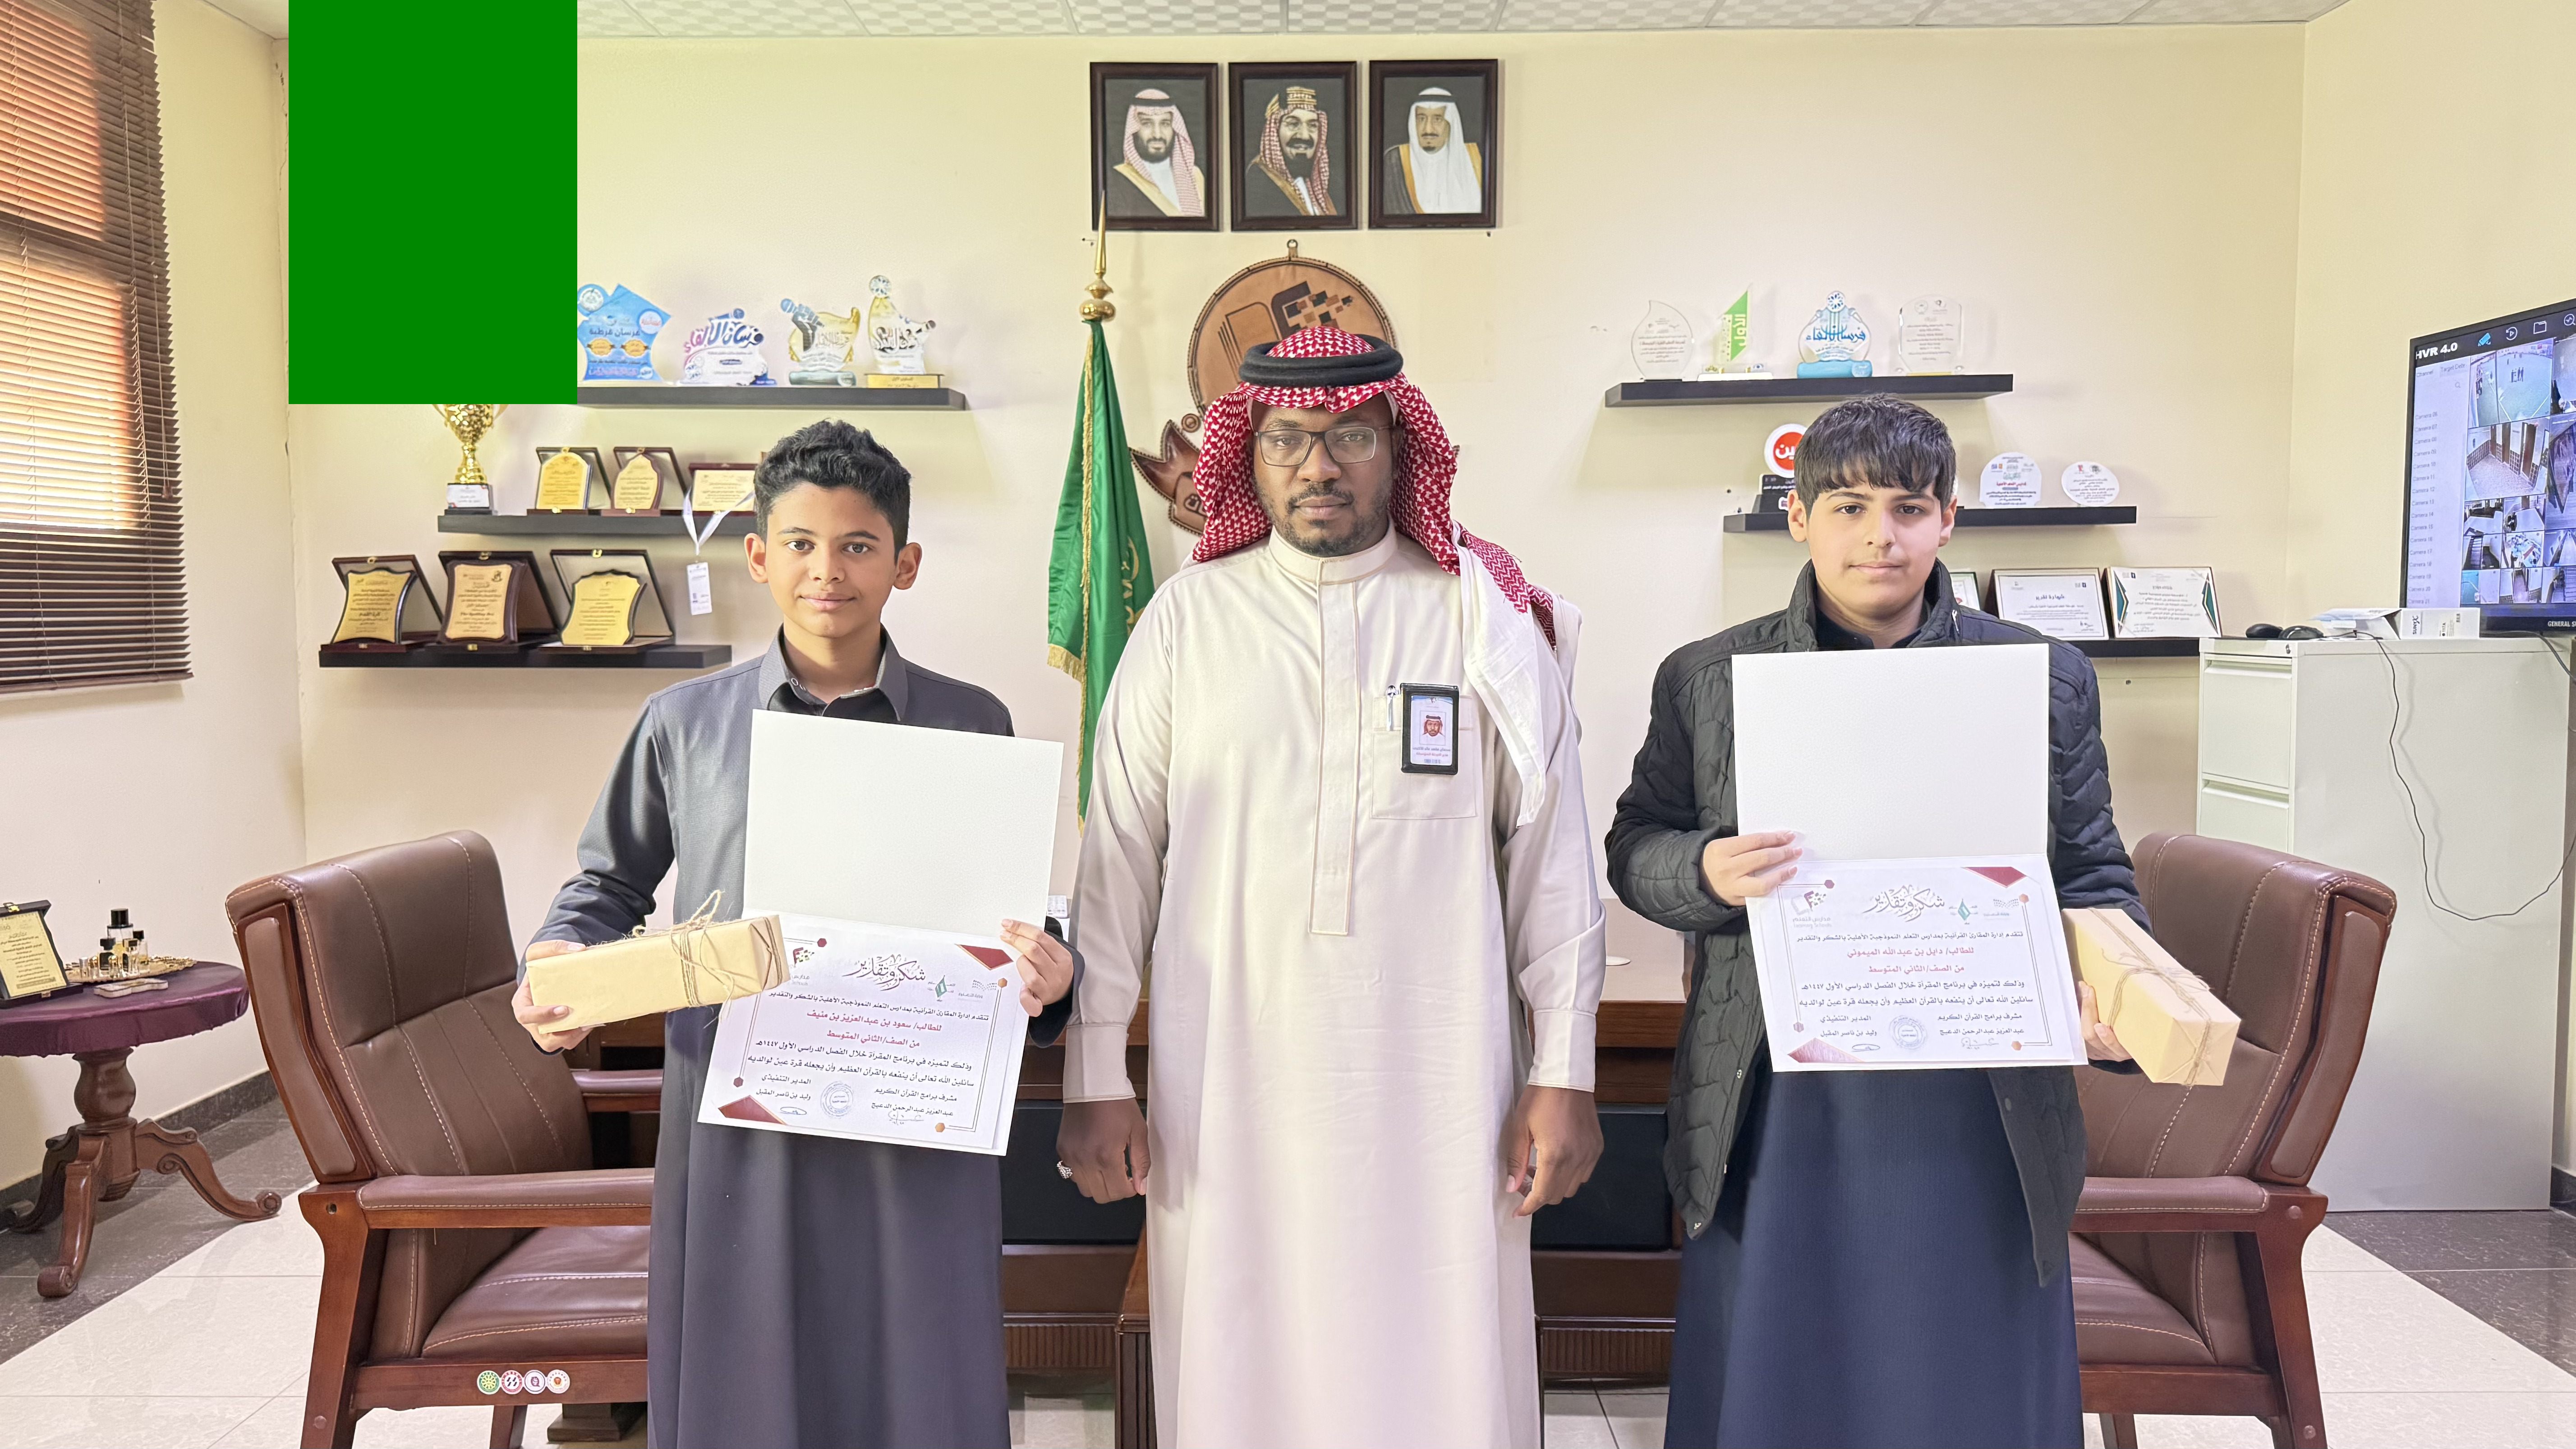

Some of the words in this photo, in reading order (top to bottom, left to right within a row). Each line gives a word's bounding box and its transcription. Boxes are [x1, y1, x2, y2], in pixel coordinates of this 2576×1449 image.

[2415, 347, 2438, 359] HVR
[2440, 342, 2458, 353] 4.0
[1775, 444, 1796, 460] ين
[1847, 949, 1880, 958] الميموني
[1869, 965, 1901, 974] المتوسط
[1845, 983, 1872, 991] الدراسي
[1874, 982, 1896, 990] الفصل
[1968, 980, 1977, 989] في
[1979, 980, 2000, 988] لتميزه
[841, 998, 871, 1007] النموذجية
[1844, 998, 1855, 1006] قرة
[1945, 996, 1965, 1004] ينفعه
[1967, 996, 1974, 1004] أن
[1976, 996, 1994, 1004] تعالى
[807, 1010, 828, 1019] منيف
[829, 1013, 839, 1021] بن
[880, 1019, 890, 1027] بن
[827, 1030, 859, 1040] المتوسط
[849, 1049, 866, 1057] خلال
[748, 1055, 773, 1064] لوالديه
[893, 1055, 915, 1064] برنامج
[916, 1058, 925, 1066] في
[804, 1061, 824, 1071] يجعله
[951, 1062, 971, 1071] وذلك
[762, 1074, 789, 1082] التنفيذي
[889, 1070, 908, 1080] ينفعه
[909, 1072, 917, 1081] أن
[938, 1094, 957, 1102] مشرف
